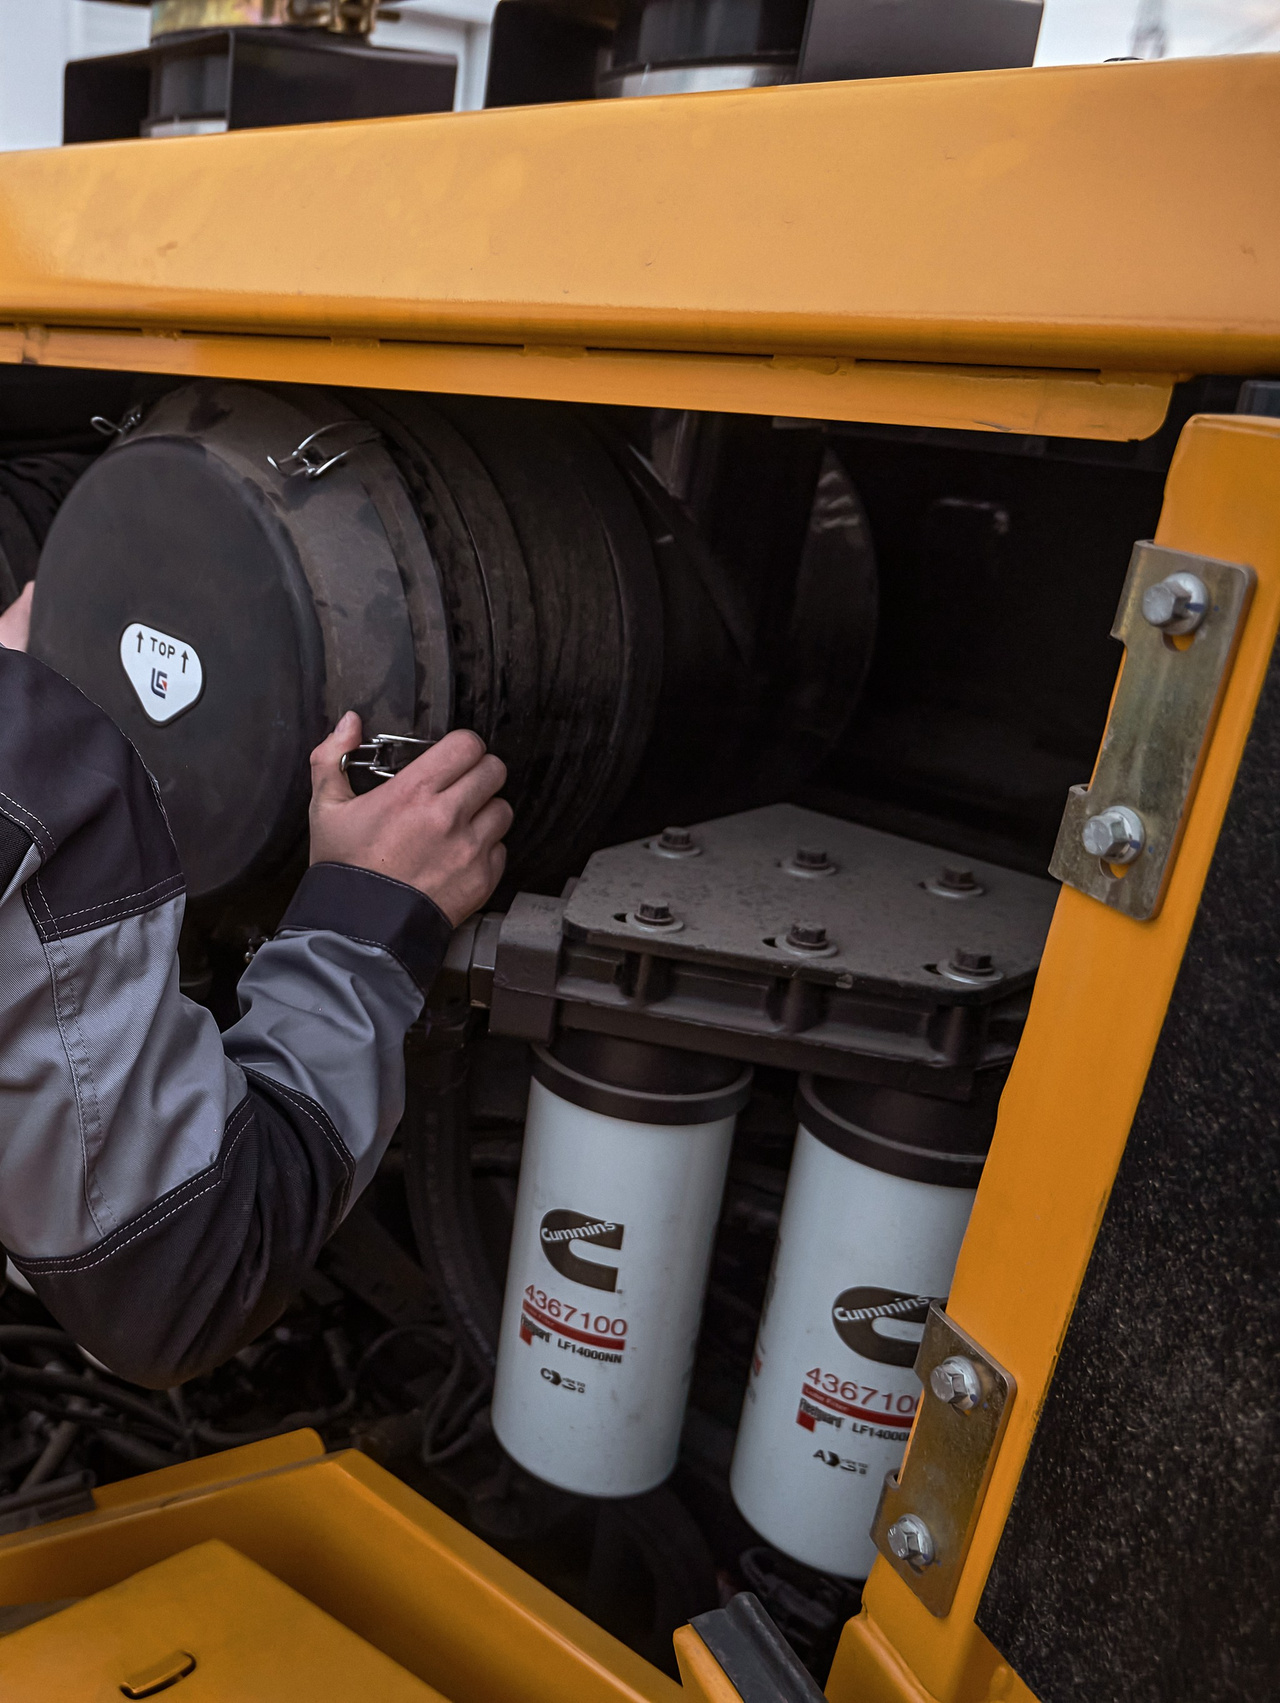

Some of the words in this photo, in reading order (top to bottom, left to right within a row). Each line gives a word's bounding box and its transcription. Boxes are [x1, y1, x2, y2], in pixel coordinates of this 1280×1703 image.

[150, 637, 176, 659] TOP
[541, 1220, 616, 1242] Cummins
[524, 1284, 628, 1337] 4367100
[833, 1295, 929, 1322] Cummins
[557, 1338, 623, 1364] LF14000NN
[806, 1367, 921, 1414] 436710
